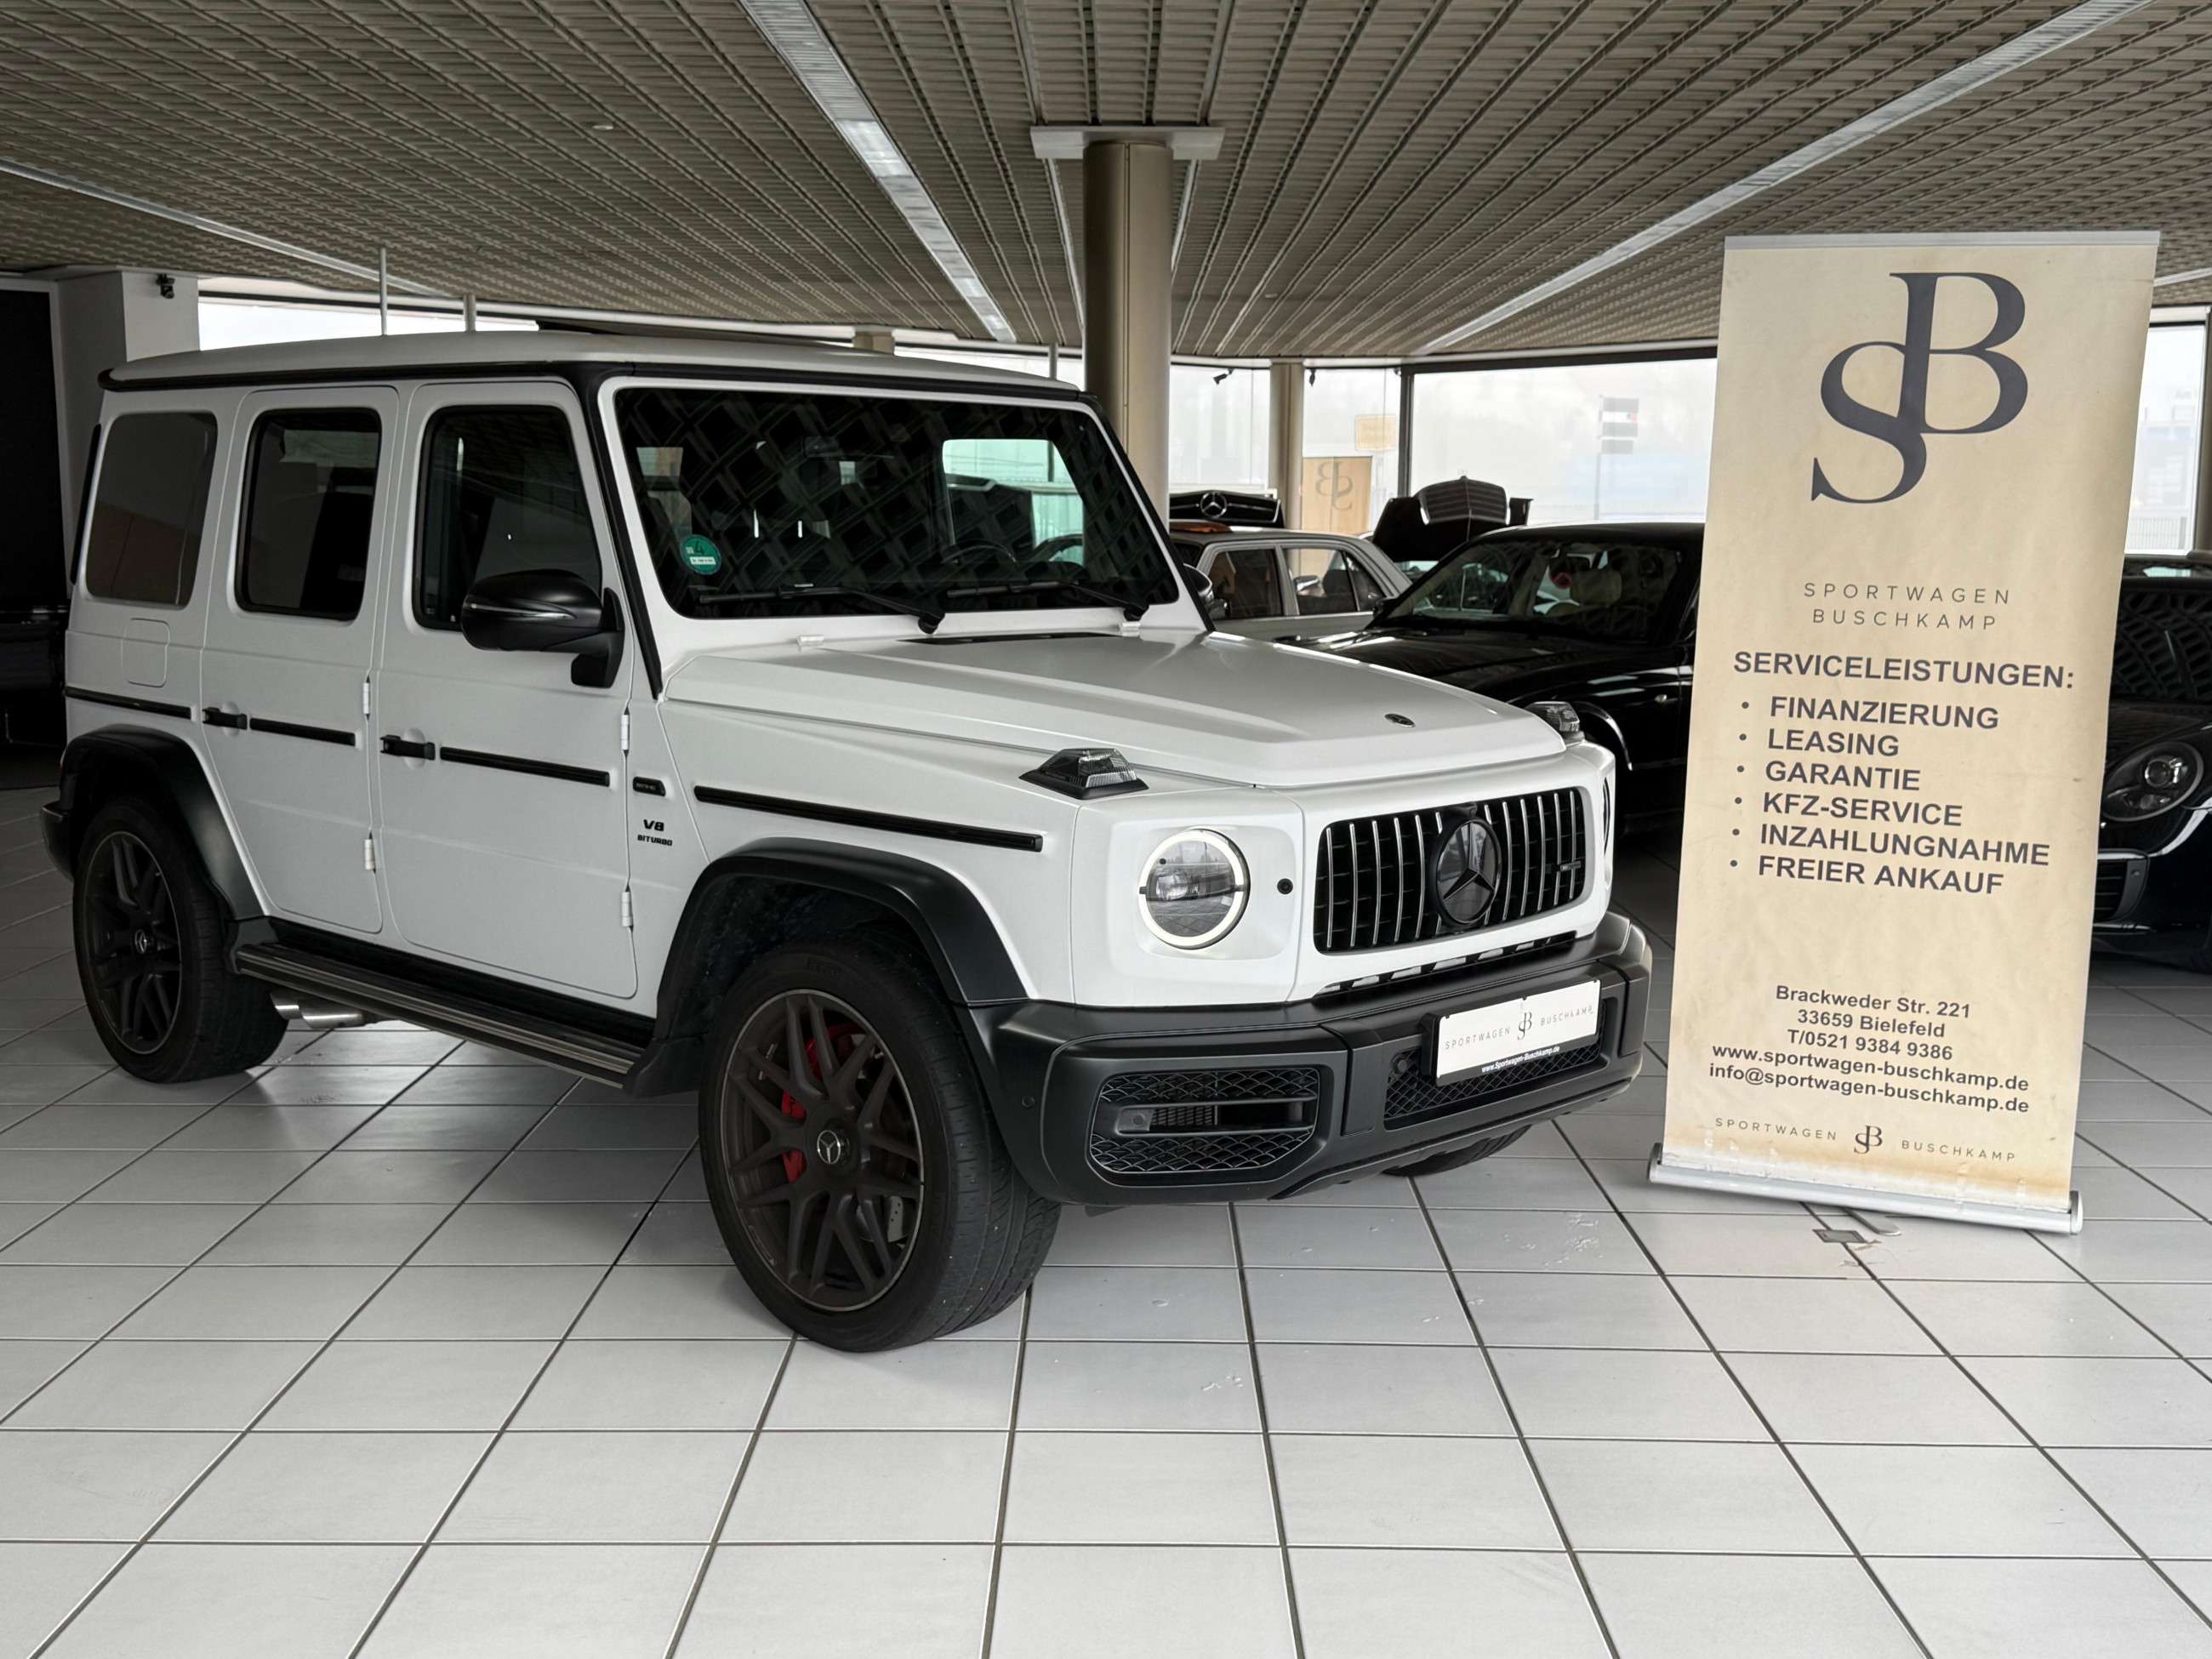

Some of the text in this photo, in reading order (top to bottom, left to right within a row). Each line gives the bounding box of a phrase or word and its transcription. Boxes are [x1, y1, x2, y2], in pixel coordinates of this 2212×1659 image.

[1804, 582, 2010, 605] SPORTWAGEN
[1812, 608, 1996, 630] BUSCHKAMP
[1733, 651, 2074, 689] SERVICELEISTUNGEN:
[1770, 696, 1999, 729] FINANZIERUNG
[1768, 728, 1900, 756] LEASING
[1764, 760, 1921, 791] GARANTIE
[643, 818, 664, 831] V8
[1763, 792, 1964, 826] KFZ-SERVICE
[636, 834, 673, 847] BITURBO
[1760, 824, 2050, 866] INZAHLUNGNAHME
[1758, 855, 2004, 895] FREIER ANKAUF
[1776, 984, 1970, 1018] Brackweder Str. 221
[1445, 1026, 1511, 1050] SPORTWAGEN
[1797, 1009, 1945, 1038] 33659 Bielefeld
[1787, 1029, 1953, 1061] T/0521 9384 9386
[1712, 1045, 2030, 1092] www.sportwagen-buschkamp.de
[1708, 1063, 2030, 1113] info@sportwagen-buschkamp.de
[1715, 1117, 1837, 1141] SPORTWAGEN
[1901, 1139, 2016, 1162] BUSCHKAMP
